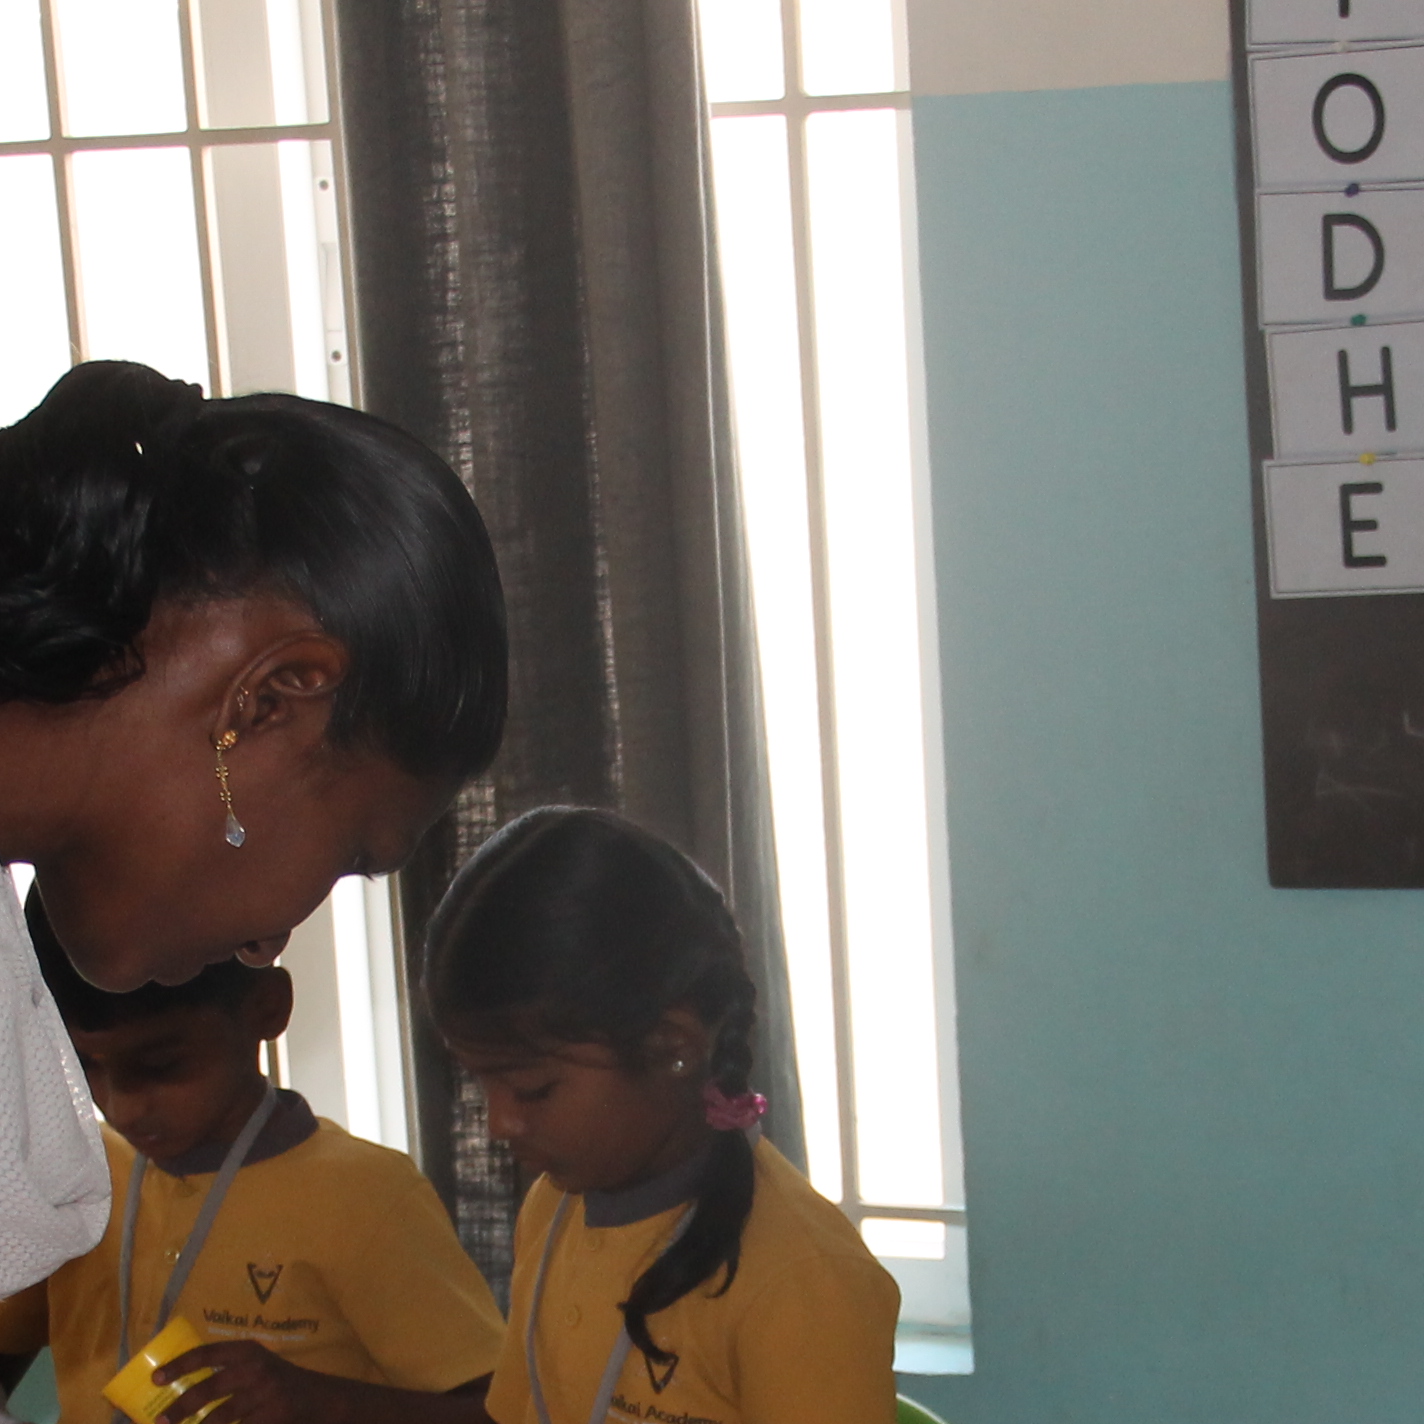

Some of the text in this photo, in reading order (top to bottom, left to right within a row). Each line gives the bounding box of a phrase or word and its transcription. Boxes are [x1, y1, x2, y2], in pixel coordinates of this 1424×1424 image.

[1312, 72, 1386, 164] O
[1323, 213, 1384, 301] D
[1337, 345, 1397, 435] H
[1341, 482, 1387, 569] E
[253, 1313, 320, 1333] Academy
